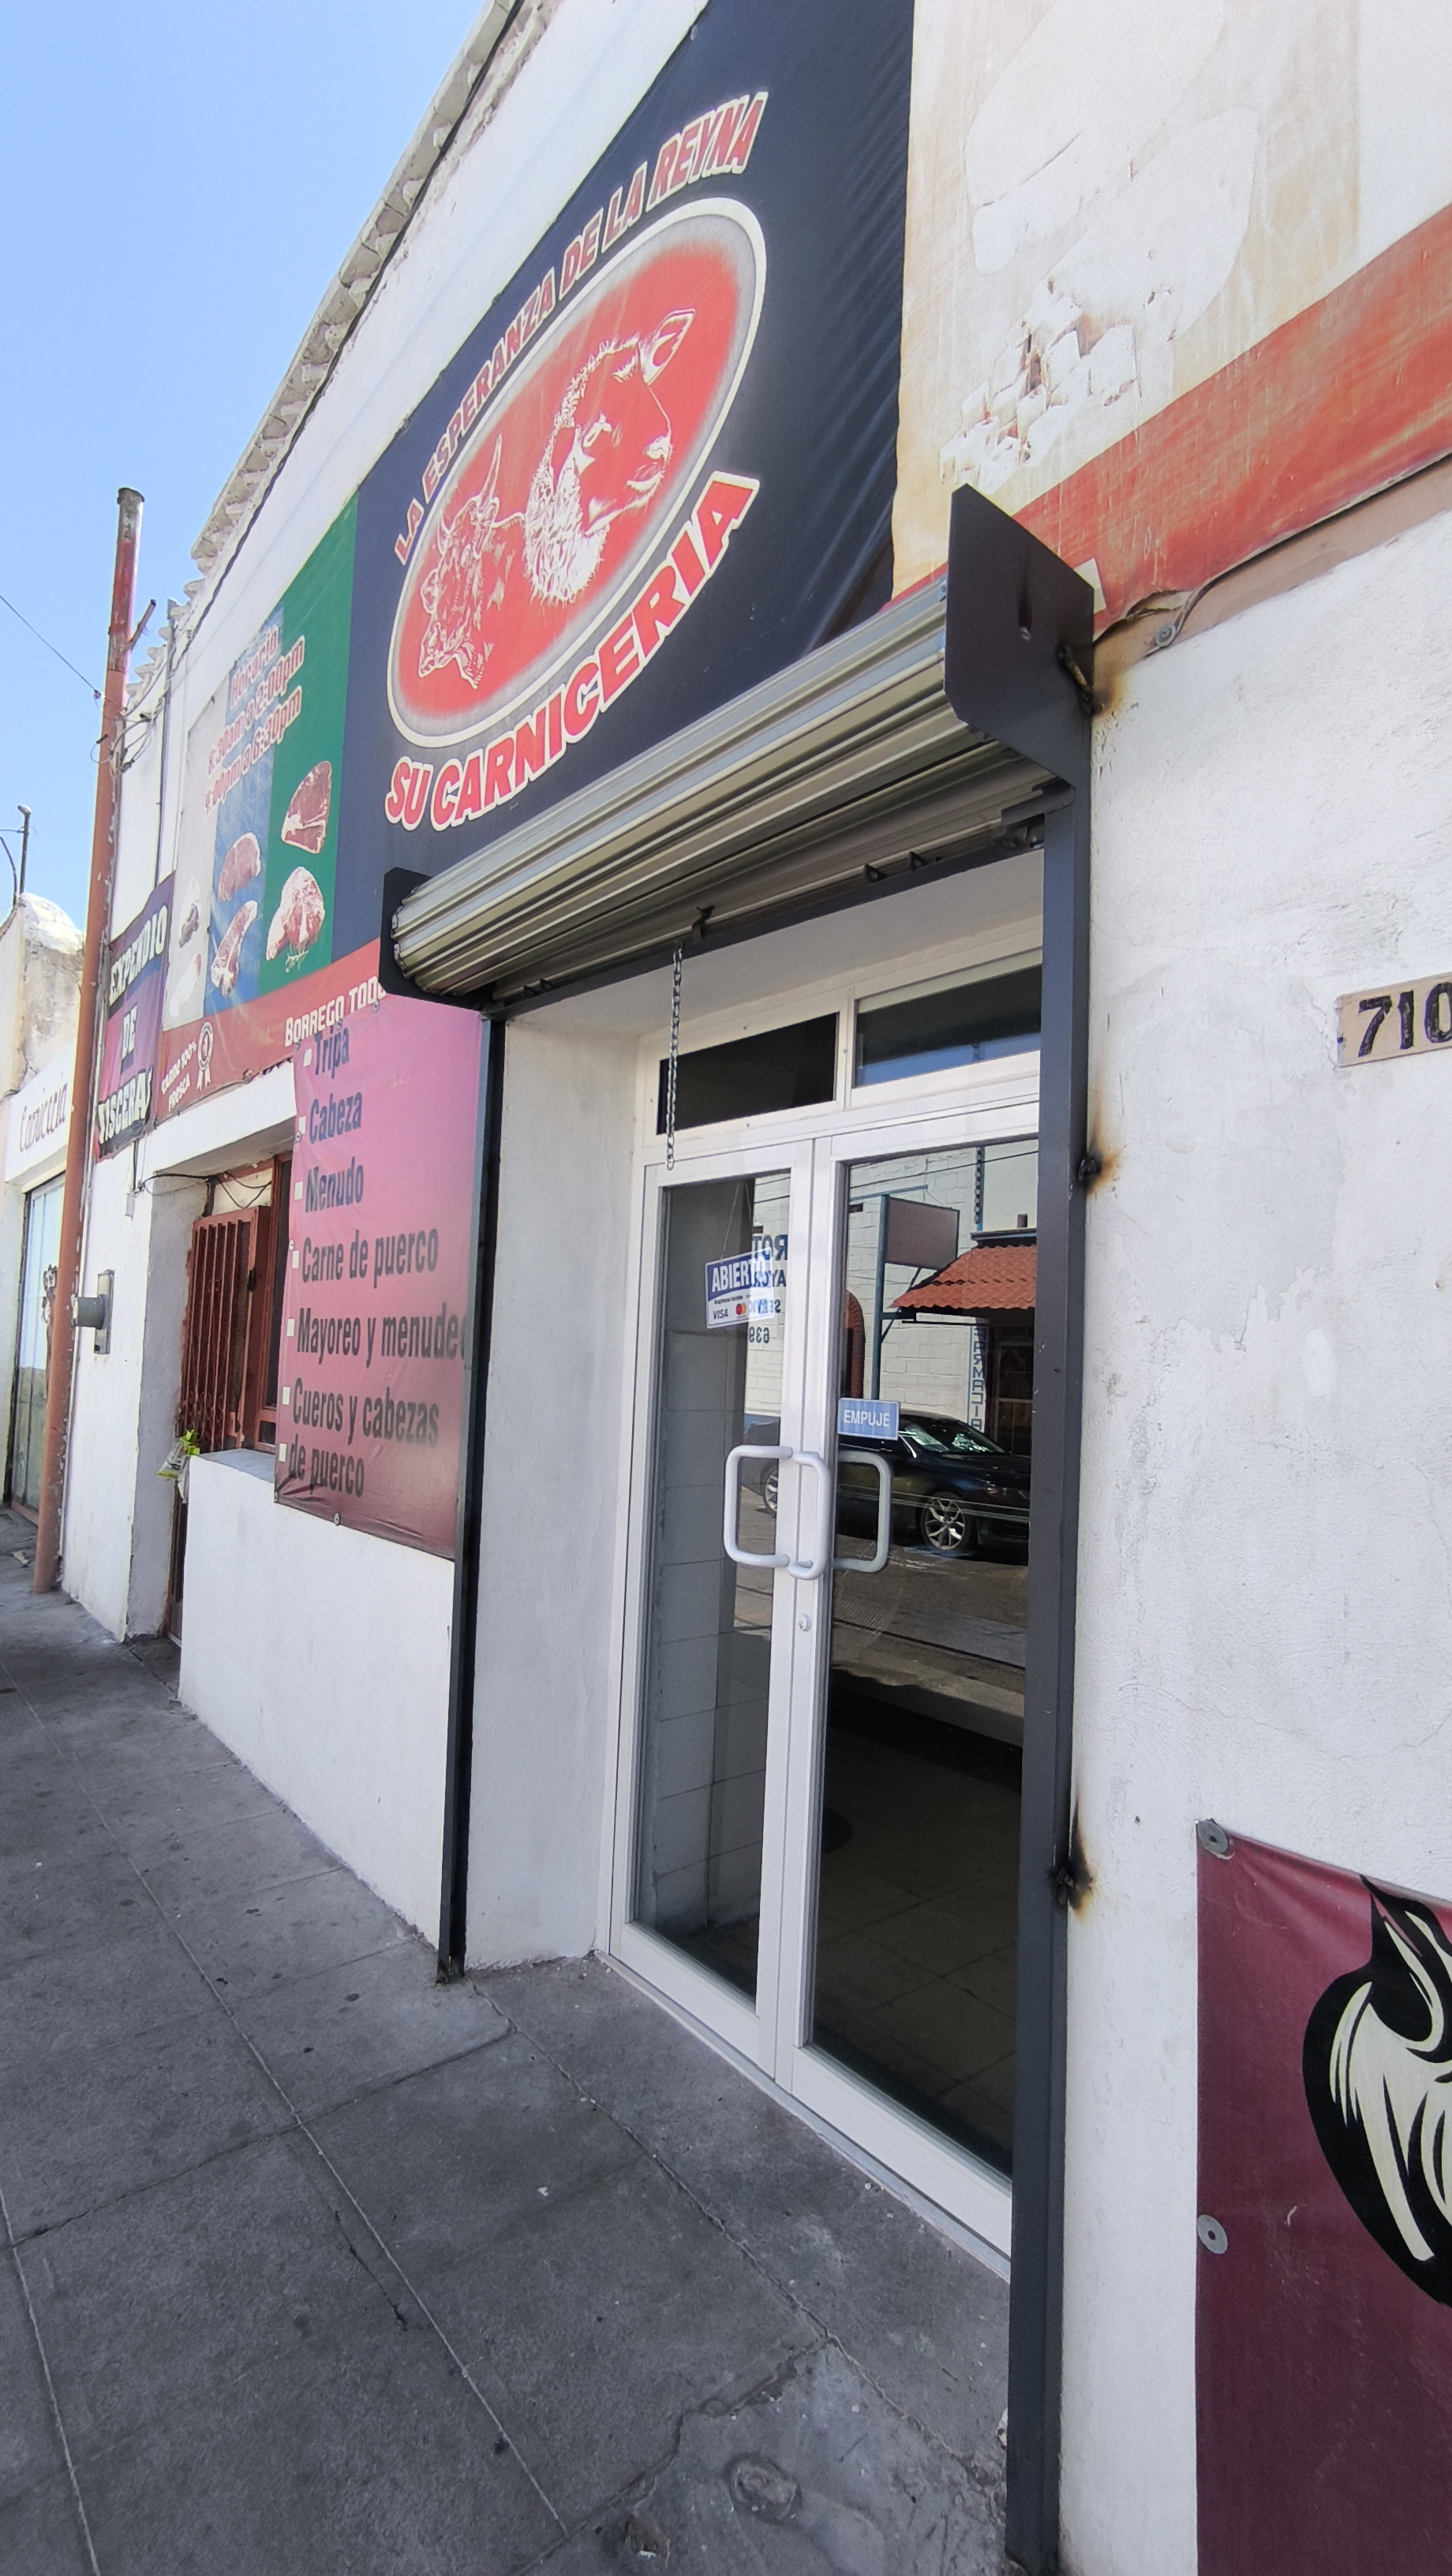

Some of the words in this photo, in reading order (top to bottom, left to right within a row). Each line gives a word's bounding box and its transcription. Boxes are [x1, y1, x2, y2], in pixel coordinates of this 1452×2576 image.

[395, 498, 424, 565] LA
[421, 267, 555, 504] ESPERANZA
[559, 208, 603, 300] DE
[602, 161, 647, 253] LA
[646, 92, 769, 212] REYNA
[230, 625, 279, 711] Horario
[385, 756, 433, 830] SU
[431, 470, 760, 831] CARNICERIA
[245, 698, 254, 731] a
[255, 635, 305, 720] 2:00pm
[241, 743, 252, 776] a
[251, 685, 302, 765] 6:30pm
[110, 905, 168, 1006] EXPENDIO
[122, 1005, 137, 1059] DE
[285, 995, 344, 1047] BORREGO
[1357, 981, 1452, 1058] 710
[314, 1026, 350, 1079] Tripa
[309, 1092, 362, 1144] Cabeza
[305, 1156, 363, 1212] Menudo
[302, 1237, 343, 1282] Carne
[350, 1230, 368, 1279] de
[373, 1229, 438, 1288] puerco
[712, 1256, 766, 1293] ABIERTO
[297, 1308, 361, 1365] Mayoreo
[366, 1317, 376, 1368] y
[713, 1308, 728, 1320] VISA
[293, 1378, 343, 1432] Cueros
[348, 1395, 358, 1445] y
[362, 1387, 440, 1447] cabezas
[844, 1409, 890, 1427] EMPUJE
[289, 1433, 305, 1481] de
[310, 1448, 364, 1498] puerco
